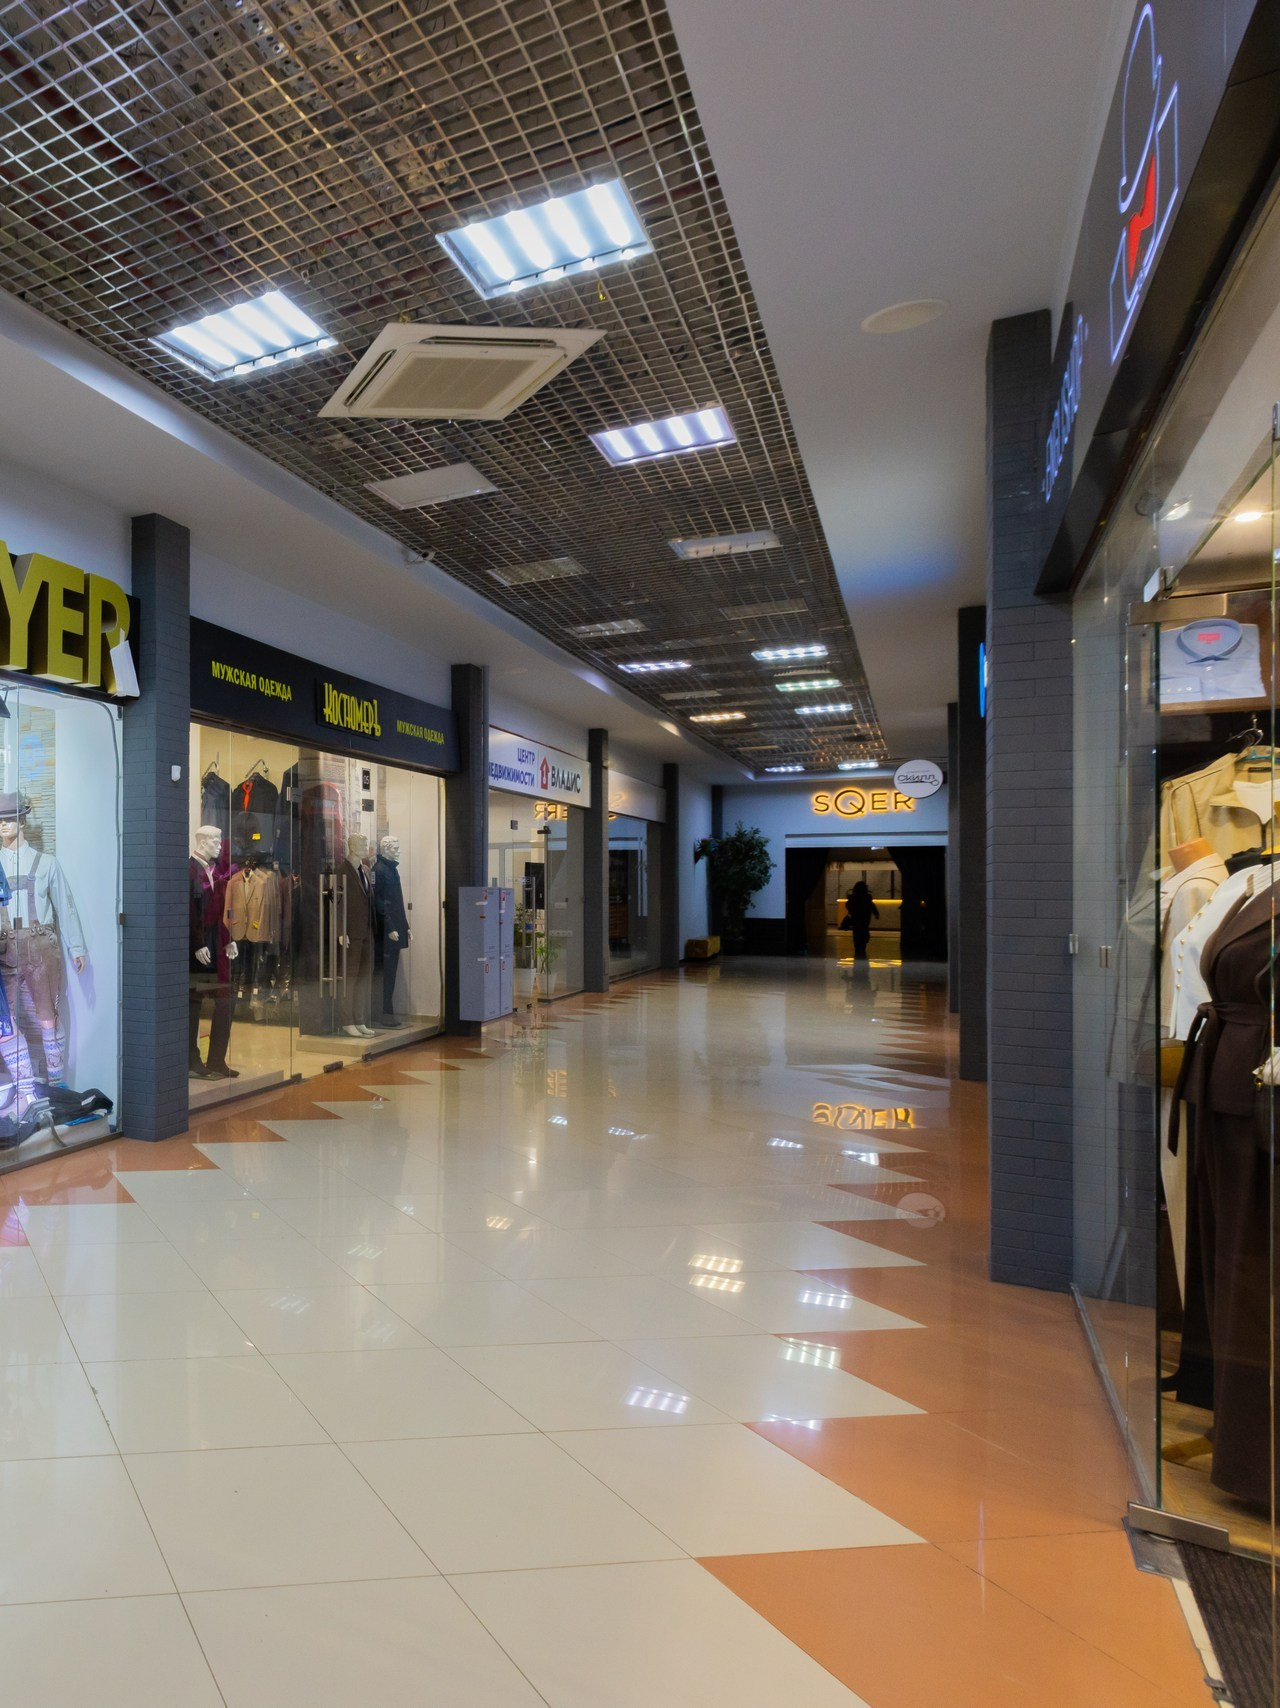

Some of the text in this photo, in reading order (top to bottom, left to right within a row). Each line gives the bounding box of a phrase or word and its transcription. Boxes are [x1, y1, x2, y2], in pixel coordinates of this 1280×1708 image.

[211, 660, 292, 702] МУЖСКАЯ ОДЕЖДА
[396, 719, 445, 745] МУЖСКАЯ ОДЕЖДА
[517, 747, 536, 765] ЦЕНТР
[551, 765, 581, 793] ВЛАДИС
[814, 789, 913, 816] SQER
